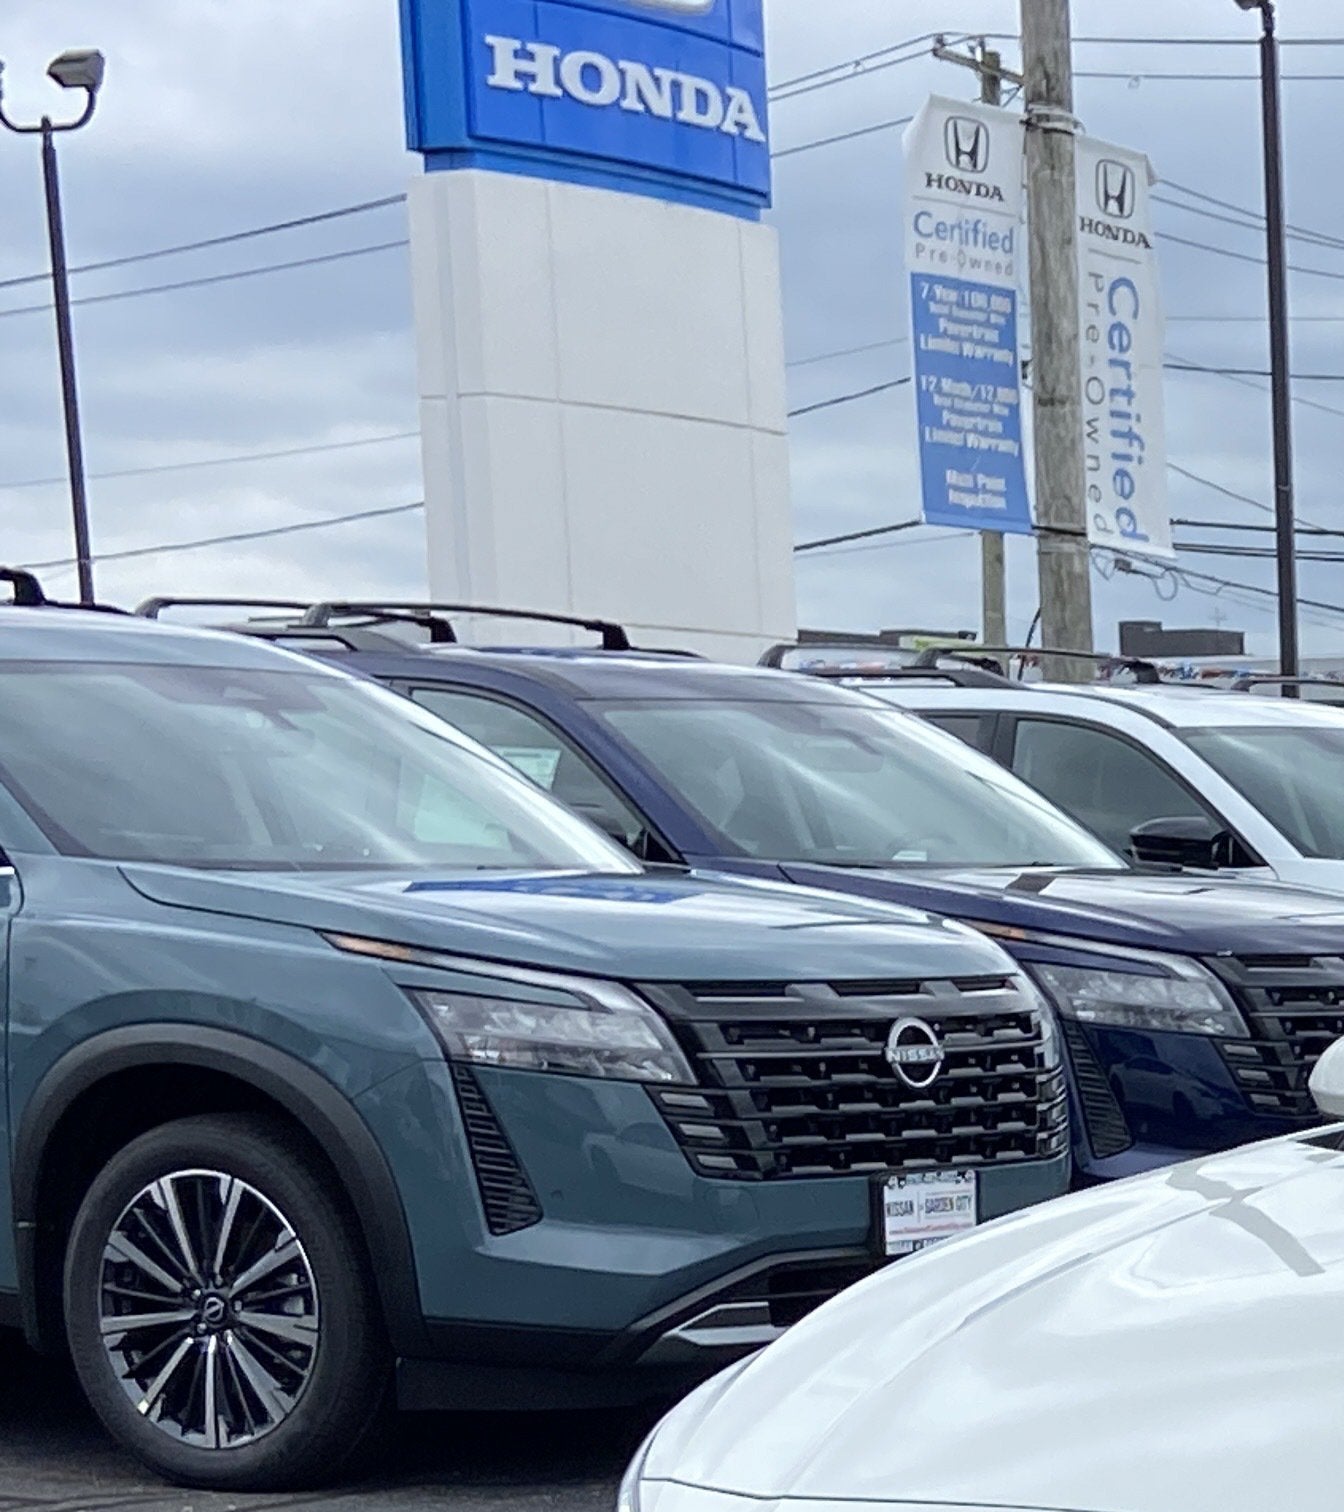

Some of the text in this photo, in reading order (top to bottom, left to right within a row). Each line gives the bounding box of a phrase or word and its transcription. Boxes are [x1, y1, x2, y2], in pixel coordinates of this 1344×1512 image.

[484, 34, 766, 142] HONDA
[924, 171, 1005, 202] HONDA
[913, 210, 1014, 255] Certified
[1079, 216, 1153, 250] HONDA
[1085, 271, 1115, 535] Pre-Owned
[1107, 276, 1150, 543] Certified
